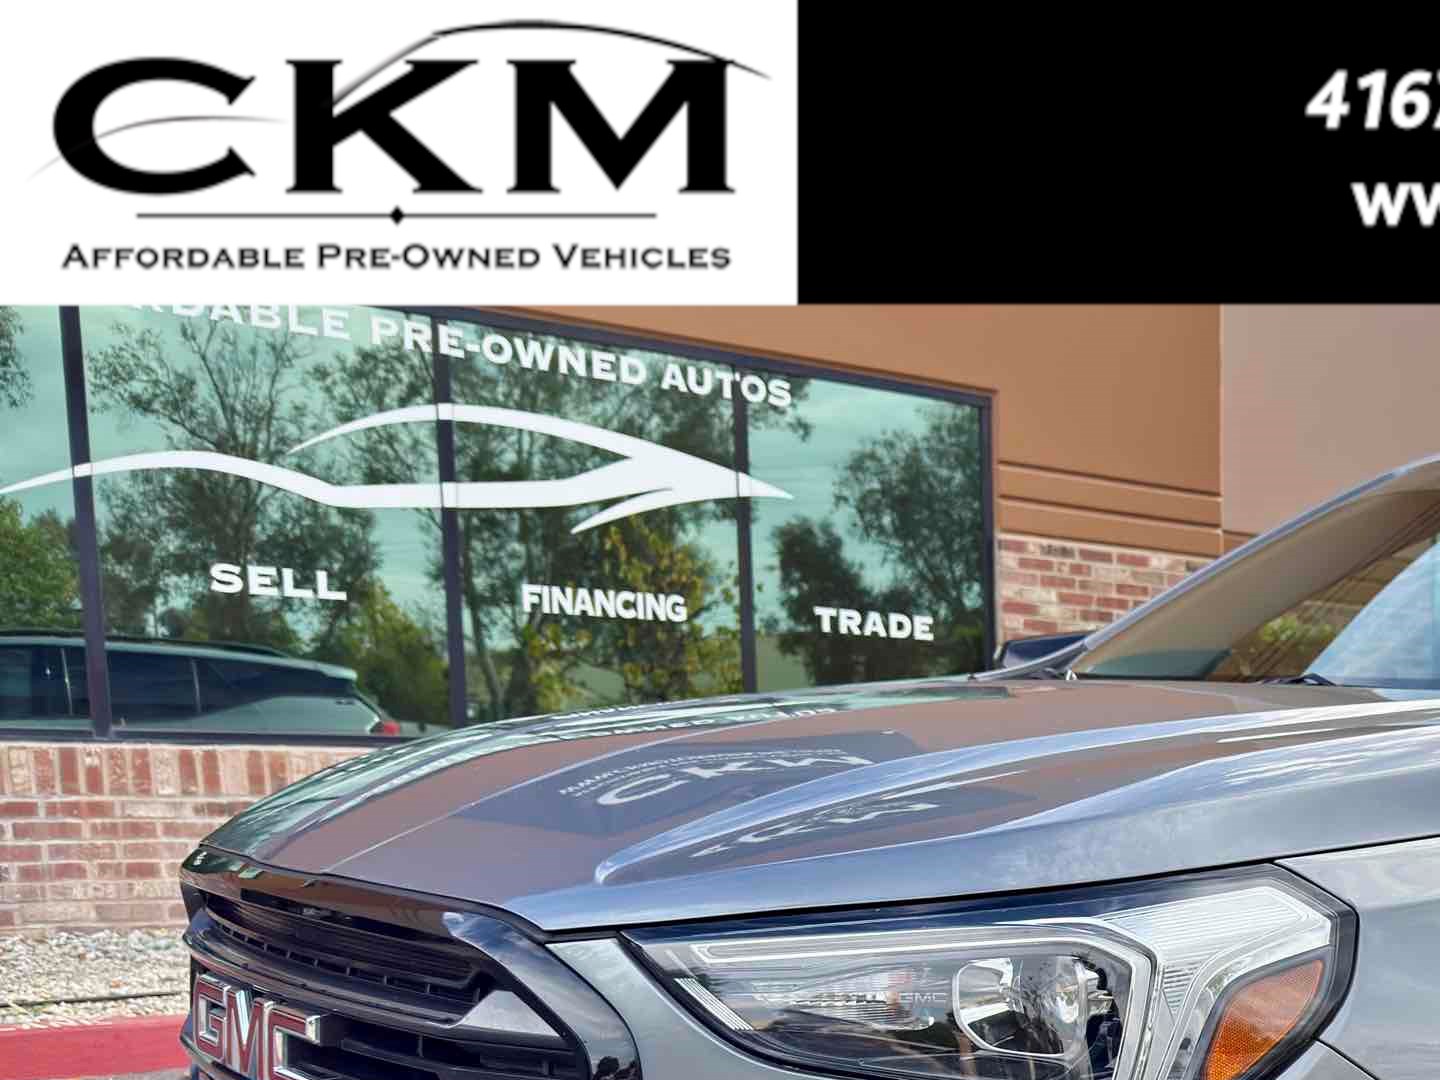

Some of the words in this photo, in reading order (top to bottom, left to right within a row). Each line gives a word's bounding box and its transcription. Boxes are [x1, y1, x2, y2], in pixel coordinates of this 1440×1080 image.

[369, 314, 649, 387] PRE-OWNED
[660, 363, 793, 408] AUTOS
[209, 563, 348, 602] SELL
[521, 582, 689, 623] FINANCING
[813, 604, 936, 642] TRADE
